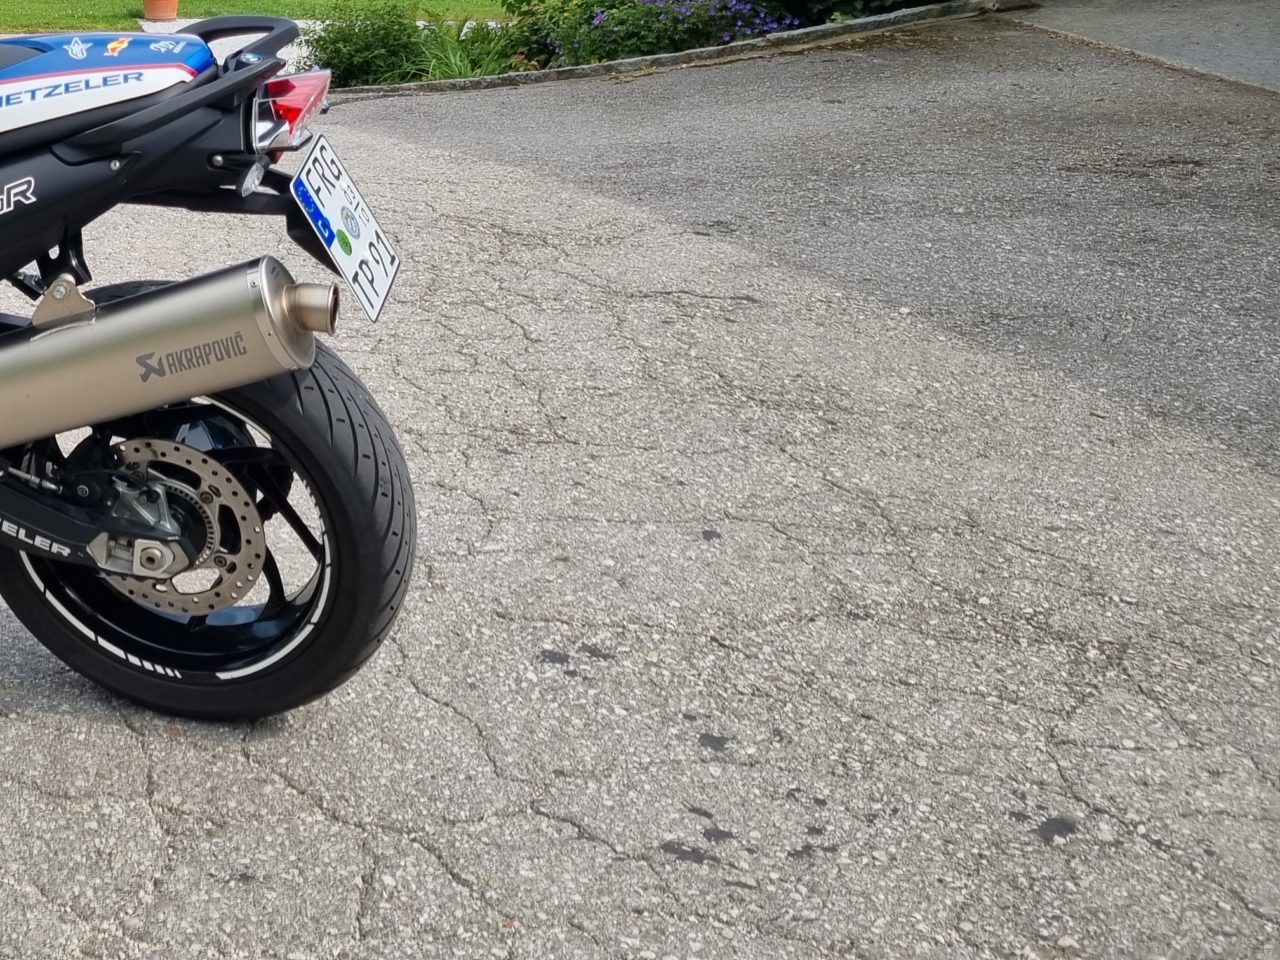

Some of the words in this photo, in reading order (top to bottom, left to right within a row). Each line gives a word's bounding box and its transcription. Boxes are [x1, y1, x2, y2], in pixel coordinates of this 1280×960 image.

[305, 144, 342, 208] FRG
[352, 259, 379, 310] TP
[368, 229, 396, 279] 91
[166, 331, 247, 375] AKRAPOVIČ
